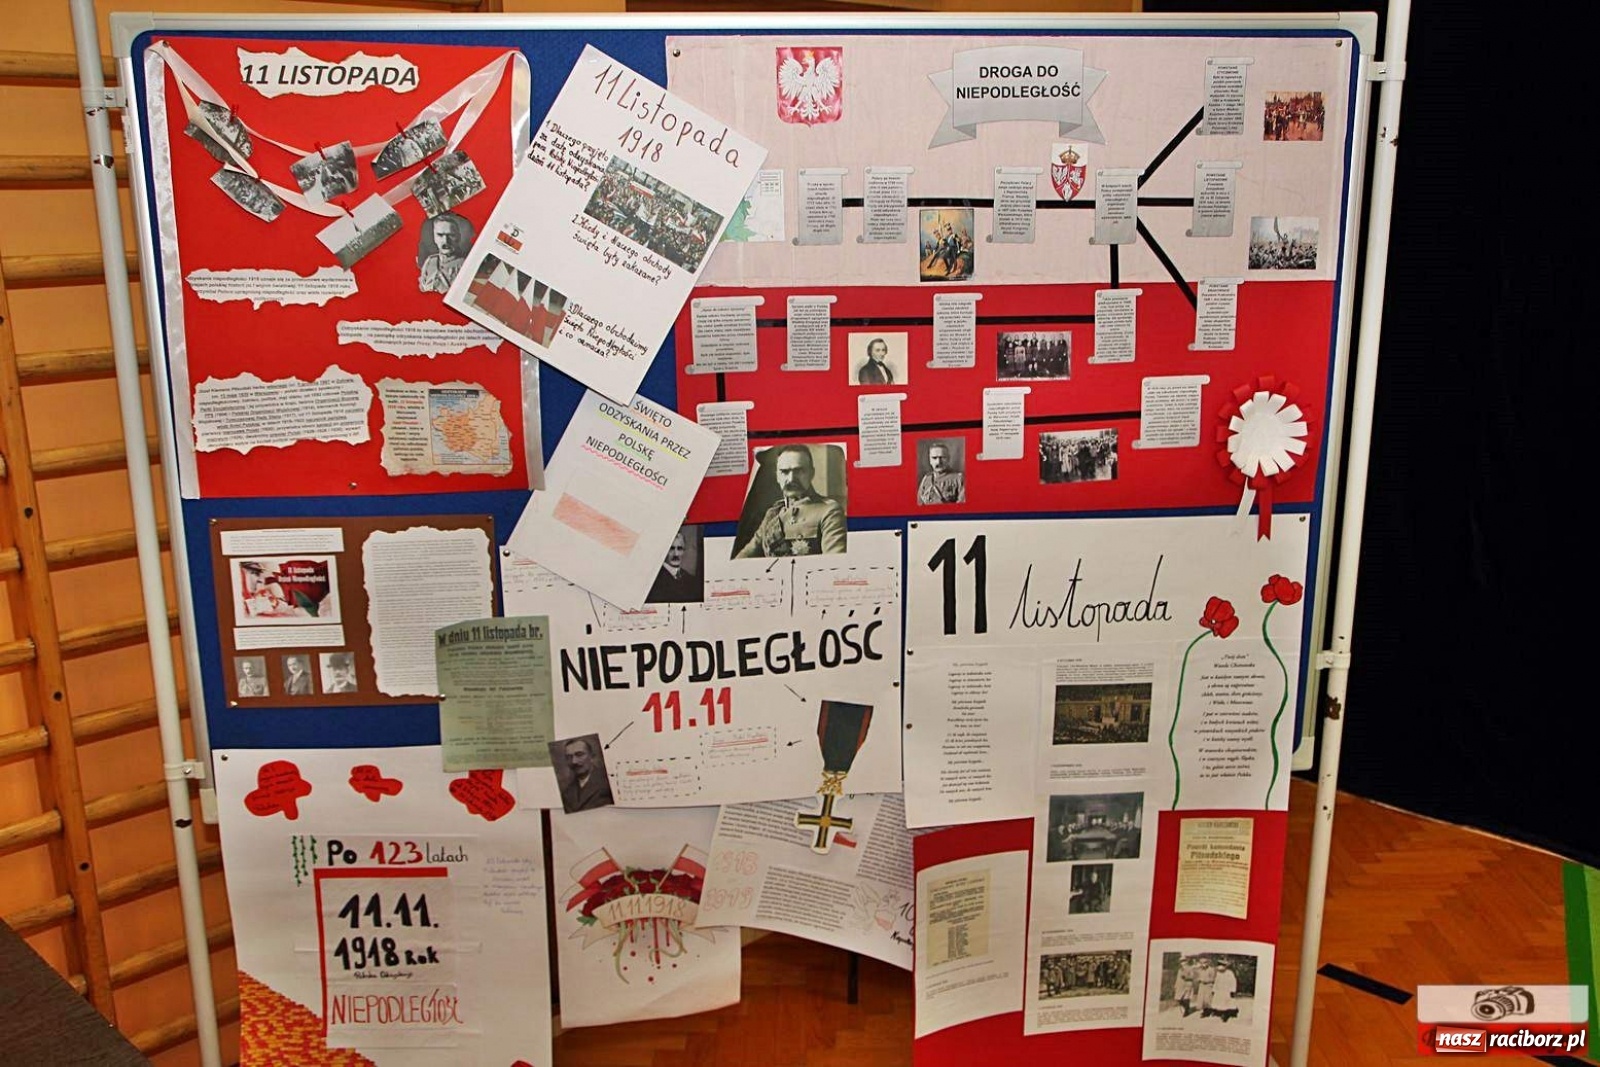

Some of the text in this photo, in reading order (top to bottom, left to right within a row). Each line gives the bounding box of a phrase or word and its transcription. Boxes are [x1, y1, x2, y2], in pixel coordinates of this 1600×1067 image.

[241, 65, 416, 86] 11 LISTOPADA
[980, 66, 1058, 78] DROGA DO
[956, 82, 1081, 99] NIEPODLEGŁOŚĆ
[595, 64, 738, 167] 11 Listopada
[618, 126, 663, 162] 1918
[598, 402, 659, 442] ODZYSKANIA
[660, 436, 691, 460] PRZEZ
[634, 400, 672, 428] ŚWIĘTO
[586, 436, 668, 487] NIEPODLEGŁOŚCI
[618, 432, 656, 462] POLSKĘ
[927, 534, 1173, 642] 11 listopada
[438, 623, 543, 644] W dniu 11 listopada br.
[560, 606, 883, 692] NIEPODLEGŁOŚĆ
[642, 686, 732, 733] 11.11
[326, 839, 468, 866] Po 123 latach
[338, 892, 439, 929] 11.11.
[334, 936, 400, 971] 1918
